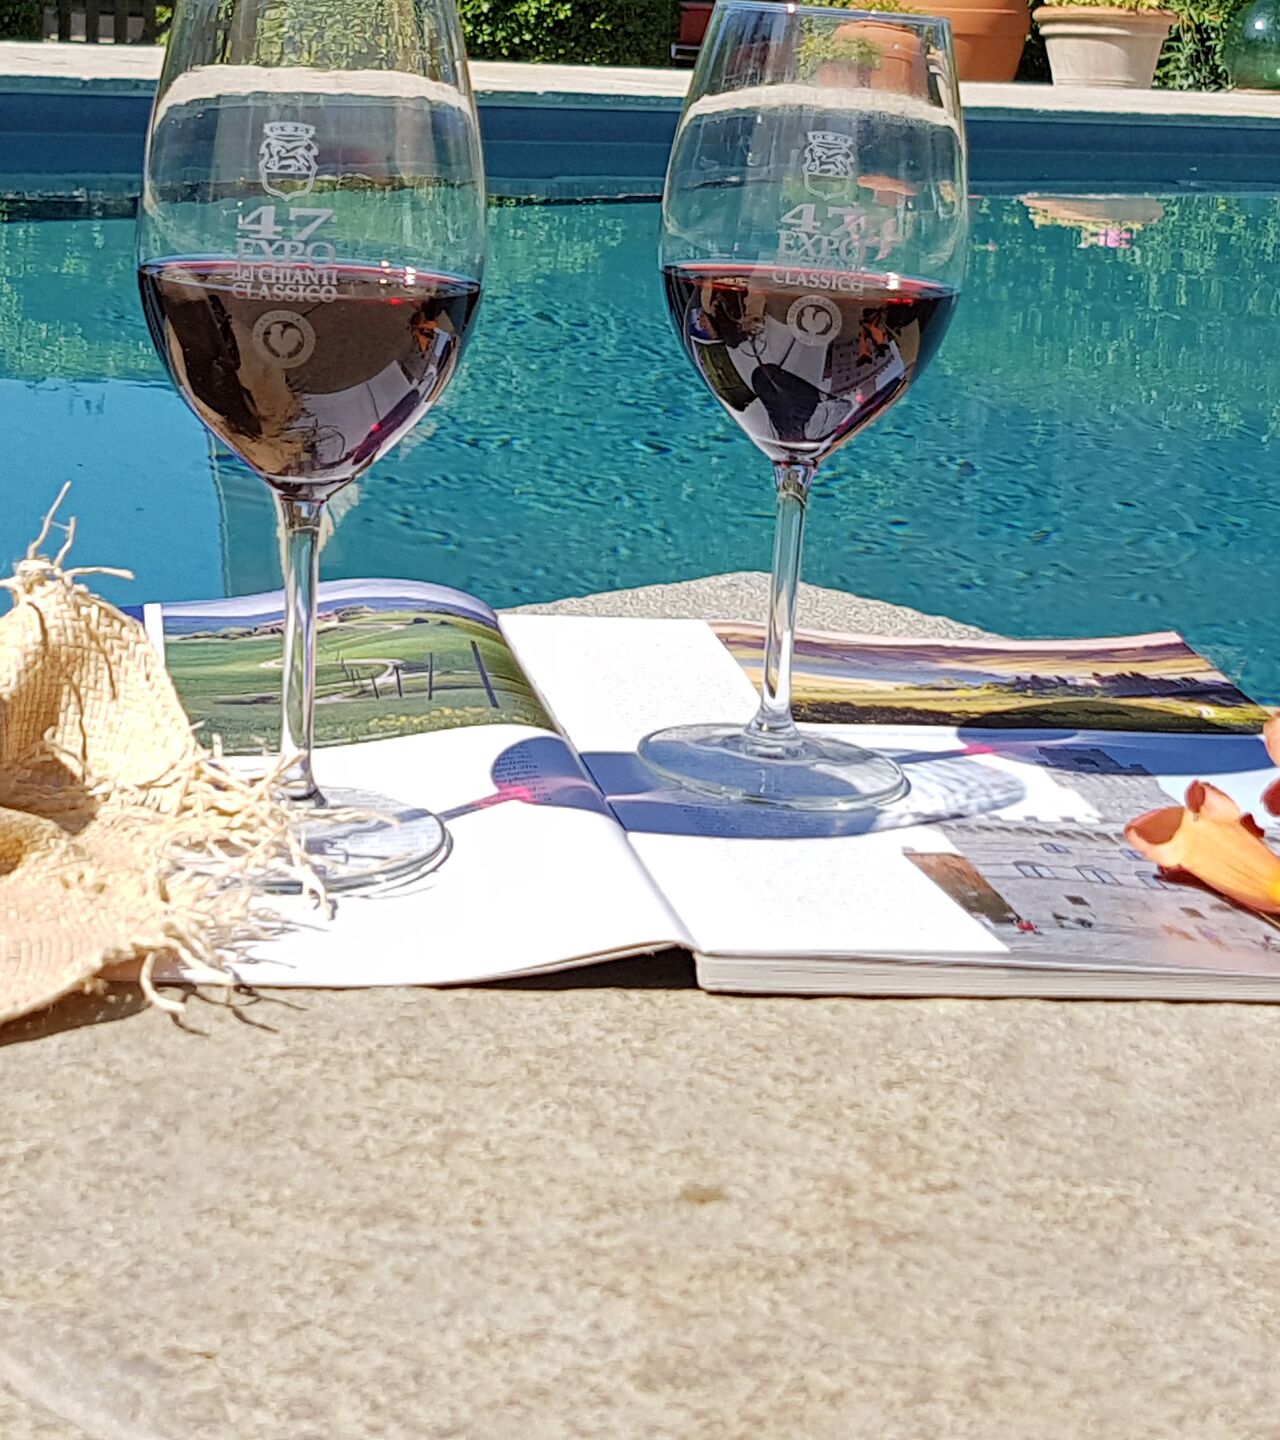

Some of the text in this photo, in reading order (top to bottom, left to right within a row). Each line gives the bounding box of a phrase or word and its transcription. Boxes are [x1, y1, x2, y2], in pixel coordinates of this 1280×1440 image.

[238, 205, 334, 241] 47
[780, 203, 865, 236] 47
[237, 238, 336, 269] EXPO
[778, 229, 864, 263] EXPO
[232, 263, 339, 286] del CHIANTI
[772, 271, 864, 293] CLASSICO
[232, 281, 338, 303] CLASSICO
